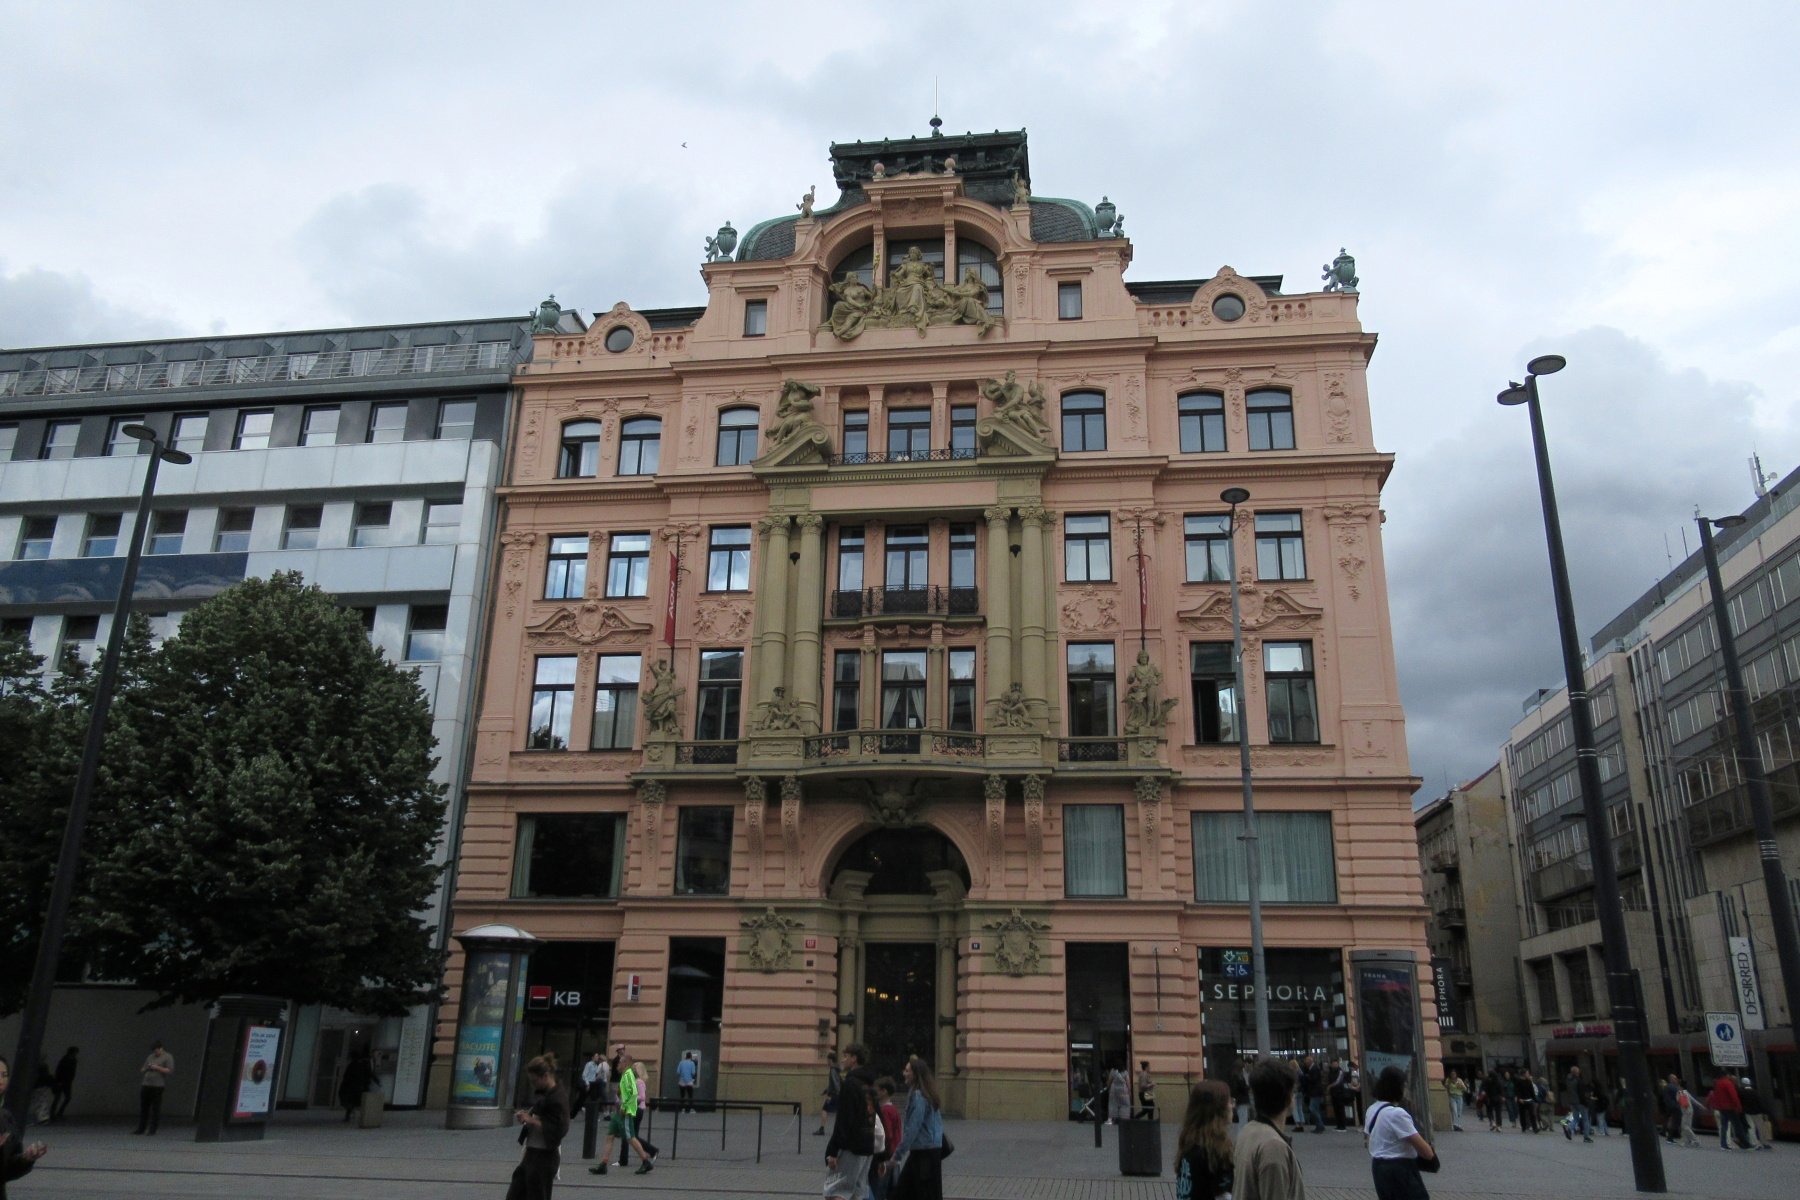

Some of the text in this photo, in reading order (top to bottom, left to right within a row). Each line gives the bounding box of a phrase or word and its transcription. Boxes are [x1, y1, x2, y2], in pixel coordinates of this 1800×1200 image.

[554, 991, 582, 1006] KB
[1435, 966, 1449, 1013] SEPHORA
[1737, 952, 1758, 1015] DESIRRED
